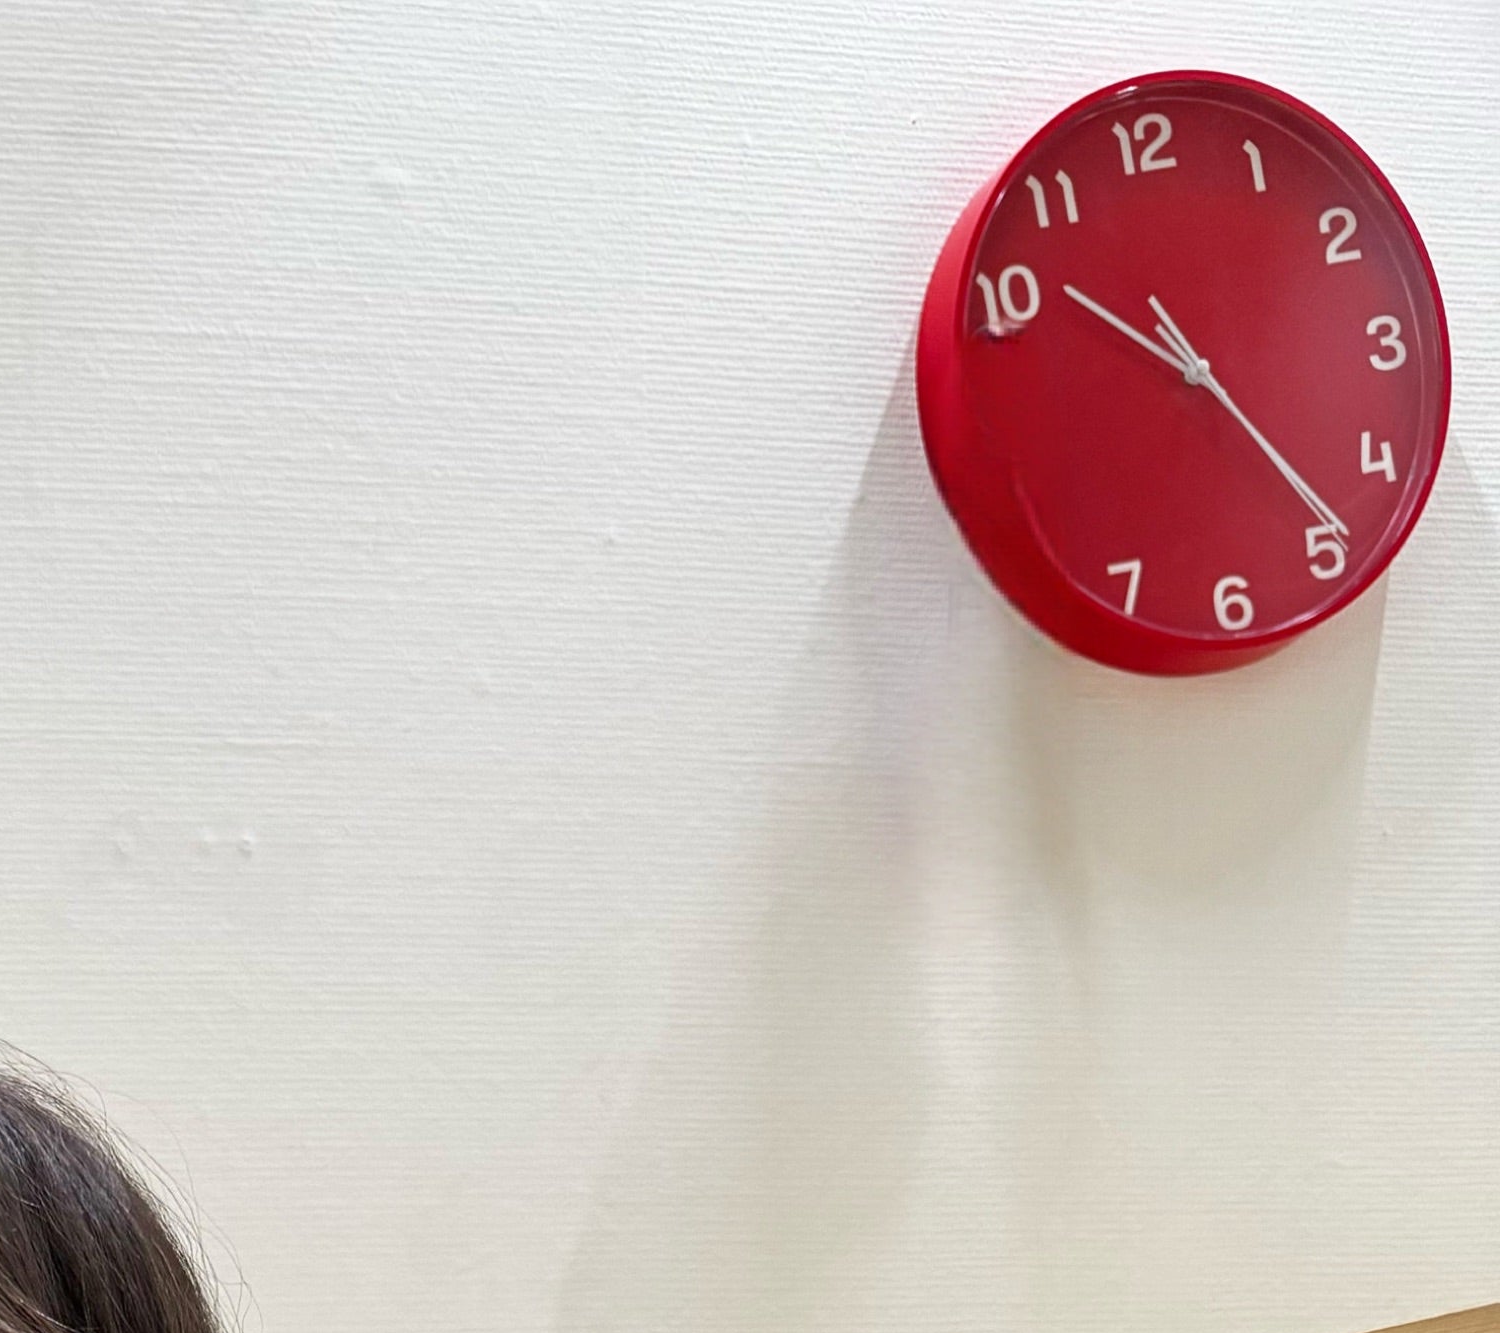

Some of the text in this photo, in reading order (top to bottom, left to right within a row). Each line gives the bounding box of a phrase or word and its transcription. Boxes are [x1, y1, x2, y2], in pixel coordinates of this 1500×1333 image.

[1112, 114, 1176, 175] 12
[1243, 140, 1266, 192] 1
[1026, 170, 1078, 228] 11
[1319, 207, 1362, 264] 2
[976, 265, 1040, 336] 10
[1366, 315, 1406, 371] 3
[1361, 431, 1397, 482] 4
[1305, 524, 1346, 580] 5
[1107, 560, 1141, 616] 7
[1213, 576, 1254, 630] 6
